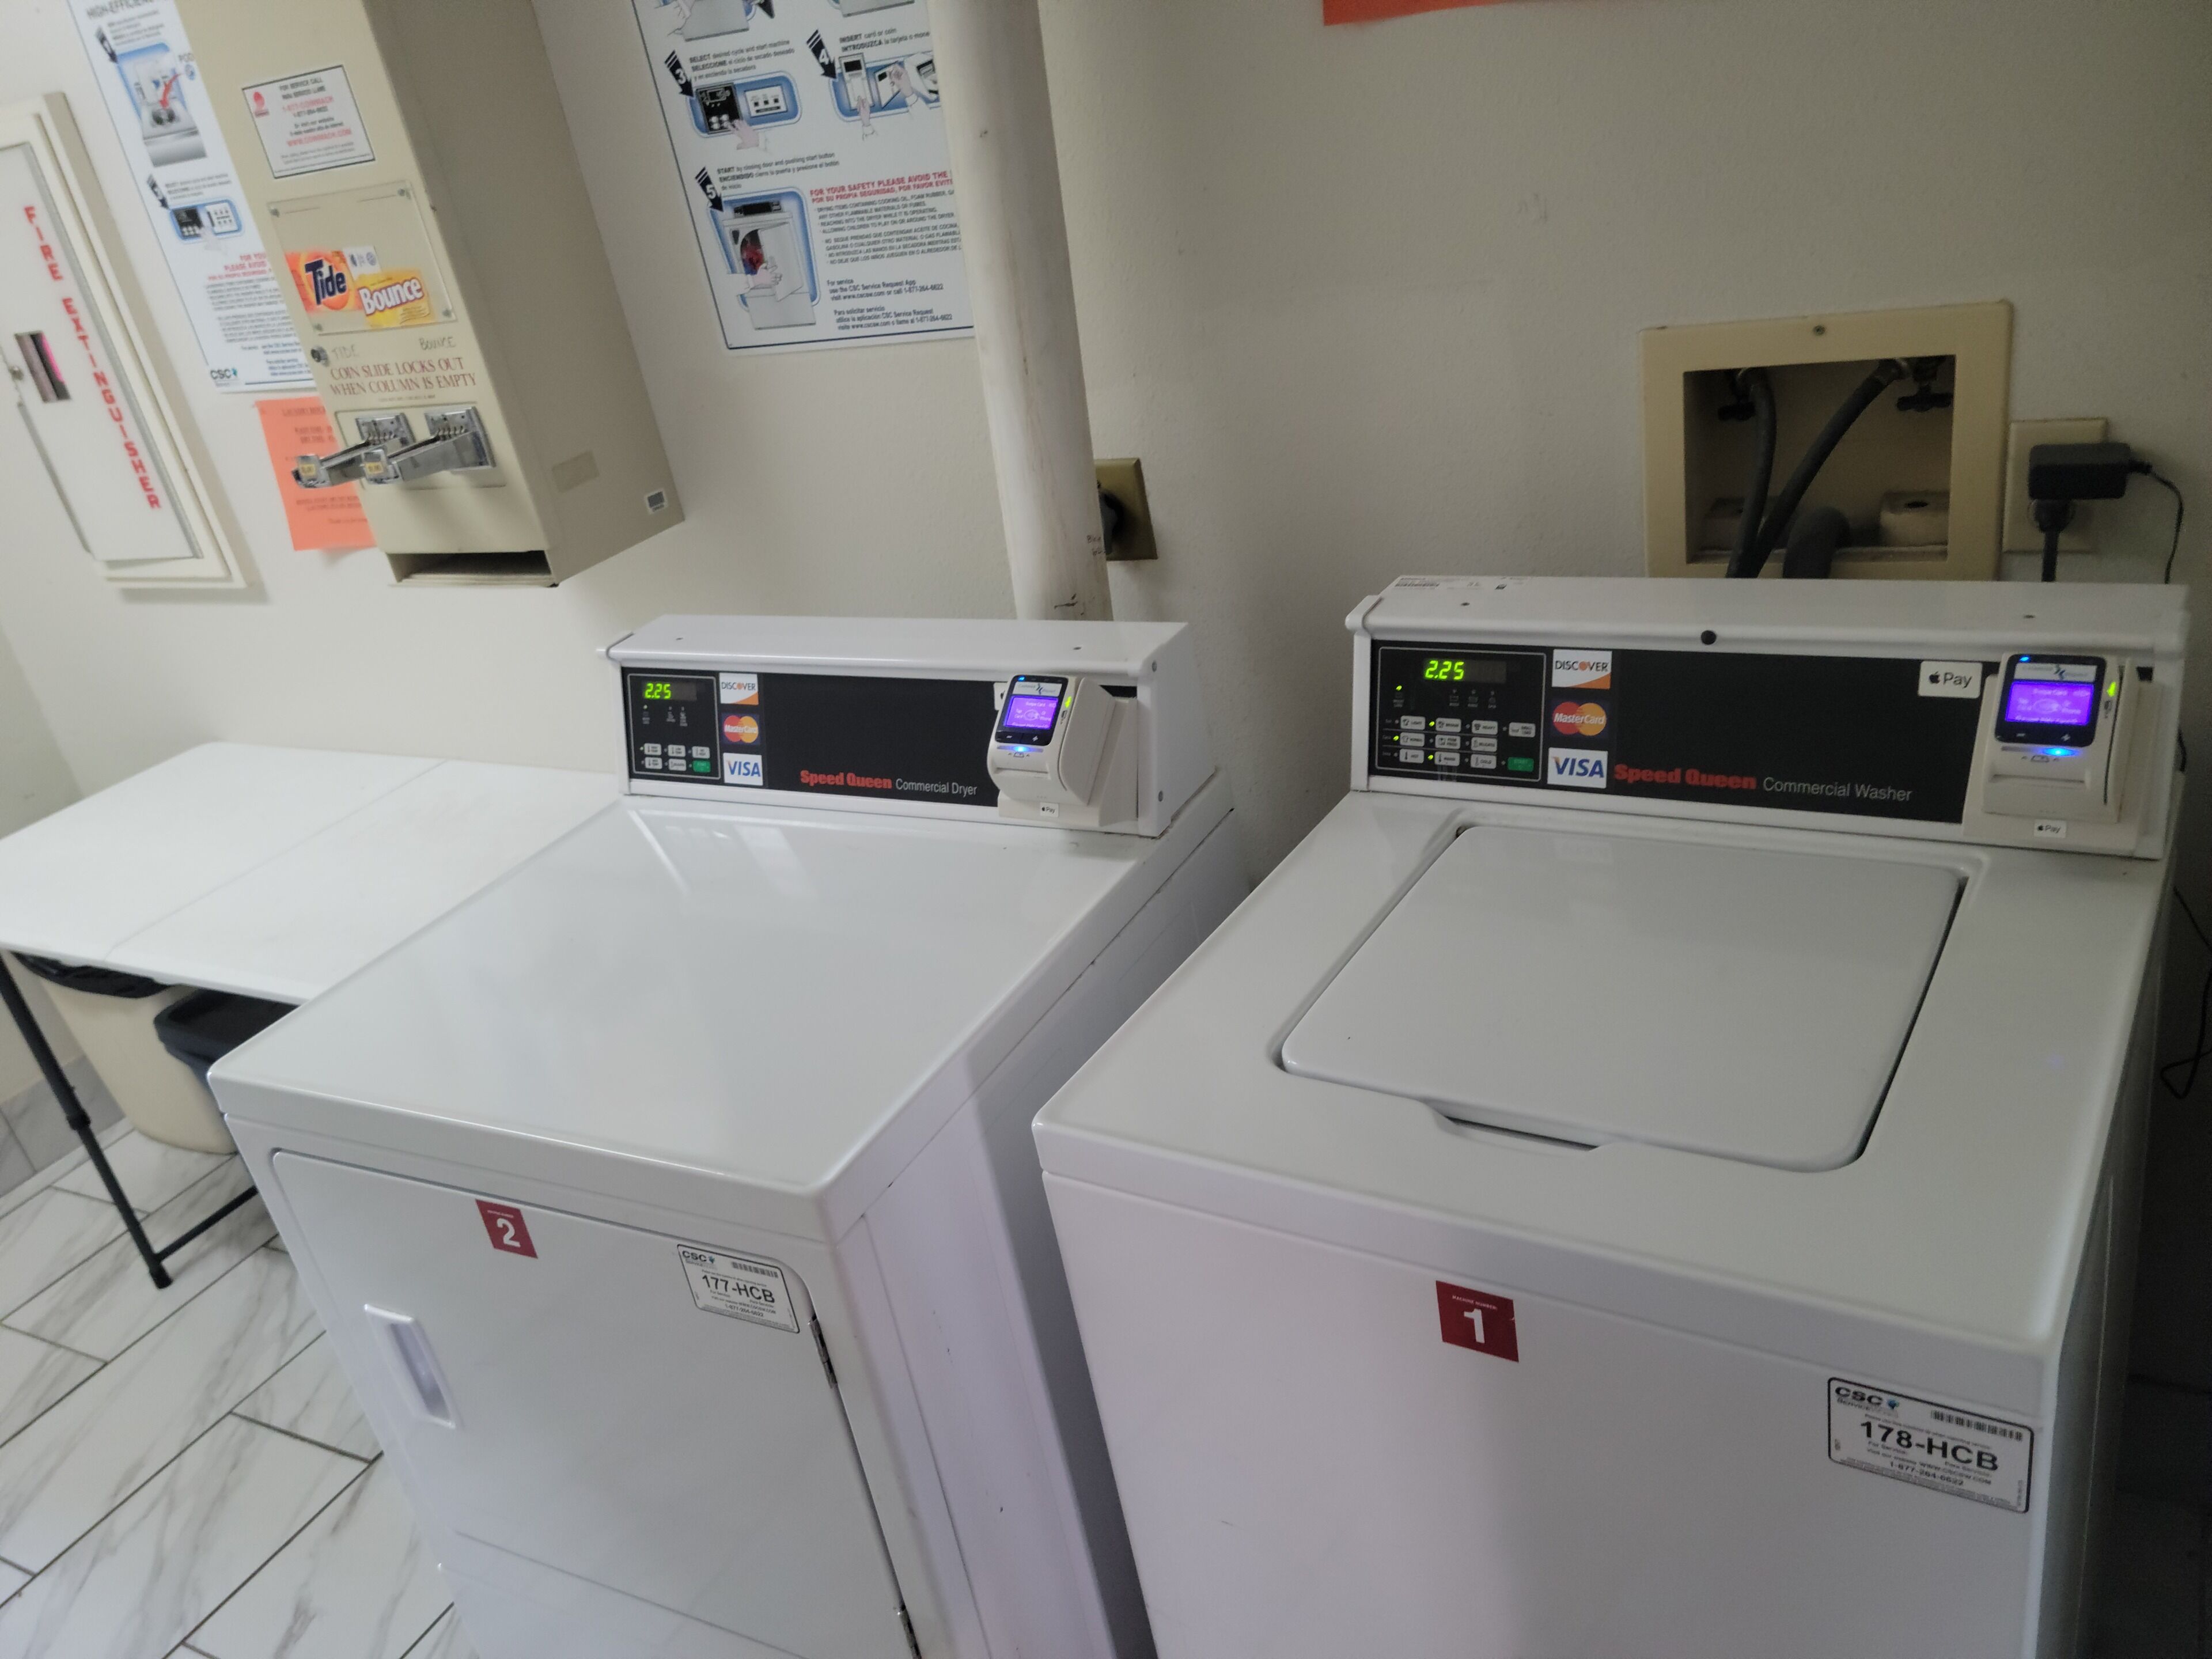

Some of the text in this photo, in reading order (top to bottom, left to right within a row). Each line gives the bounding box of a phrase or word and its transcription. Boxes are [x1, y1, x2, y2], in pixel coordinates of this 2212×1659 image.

[839, 33, 861, 43] INSERT
[690, 54, 710, 63] SELECT
[746, 46, 755, 54] and
[756, 44, 766, 52] start
[768, 40, 790, 50] machine
[819, 48, 831, 65] 4
[675, 69, 687, 85] 3
[717, 166, 734, 174] START
[819, 153, 835, 161] button
[705, 183, 716, 200] 5
[810, 171, 948, 196] FOR YOUR SAFETY PLEASE AVOID THE
[812, 196, 823, 204] POR
[835, 191, 857, 200] PROPIA
[898, 184, 911, 192] POR
[912, 181, 933, 190] FAVOR
[24, 205, 63, 281] FIRE
[304, 258, 347, 306] Tide
[359, 278, 423, 316] Bounce
[866, 305, 885, 313] servicio
[332, 344, 359, 359] TIDE
[210, 368, 232, 380] CSC
[331, 357, 464, 380] COIN SLIDE LOCKS OUT
[330, 373, 476, 396] WHEN COLUMN IS EMPTY
[63, 298, 161, 509] EXTINGUISHER
[1425, 660, 1464, 680] 2.25
[1555, 660, 1608, 672] DISCOVER
[721, 681, 756, 691] DISCOVER
[1944, 672, 1972, 688] Pay
[645, 683, 671, 699] 2.25
[725, 724, 758, 734] MasterCard
[1555, 713, 1605, 725] MasterCard
[727, 760, 761, 777] VISA
[1554, 757, 1604, 778] VISA
[800, 770, 978, 797] Speed Queen Commercial Dryer
[1615, 764, 1912, 801] Speed Queen Commercial Washer
[2045, 824, 2061, 834] Pay
[497, 1218, 521, 1248] 2
[682, 1250, 707, 1262] CSC
[702, 1274, 775, 1304] 177-HCB
[1452, 1295, 1475, 1304] MACHINE
[1464, 1308, 1485, 1344] 1
[1835, 1387, 1883, 1406] CSC
[1861, 1421, 1998, 1471] 178-HCB
[1891, 1461, 1964, 1486] 1-877-264-6622
